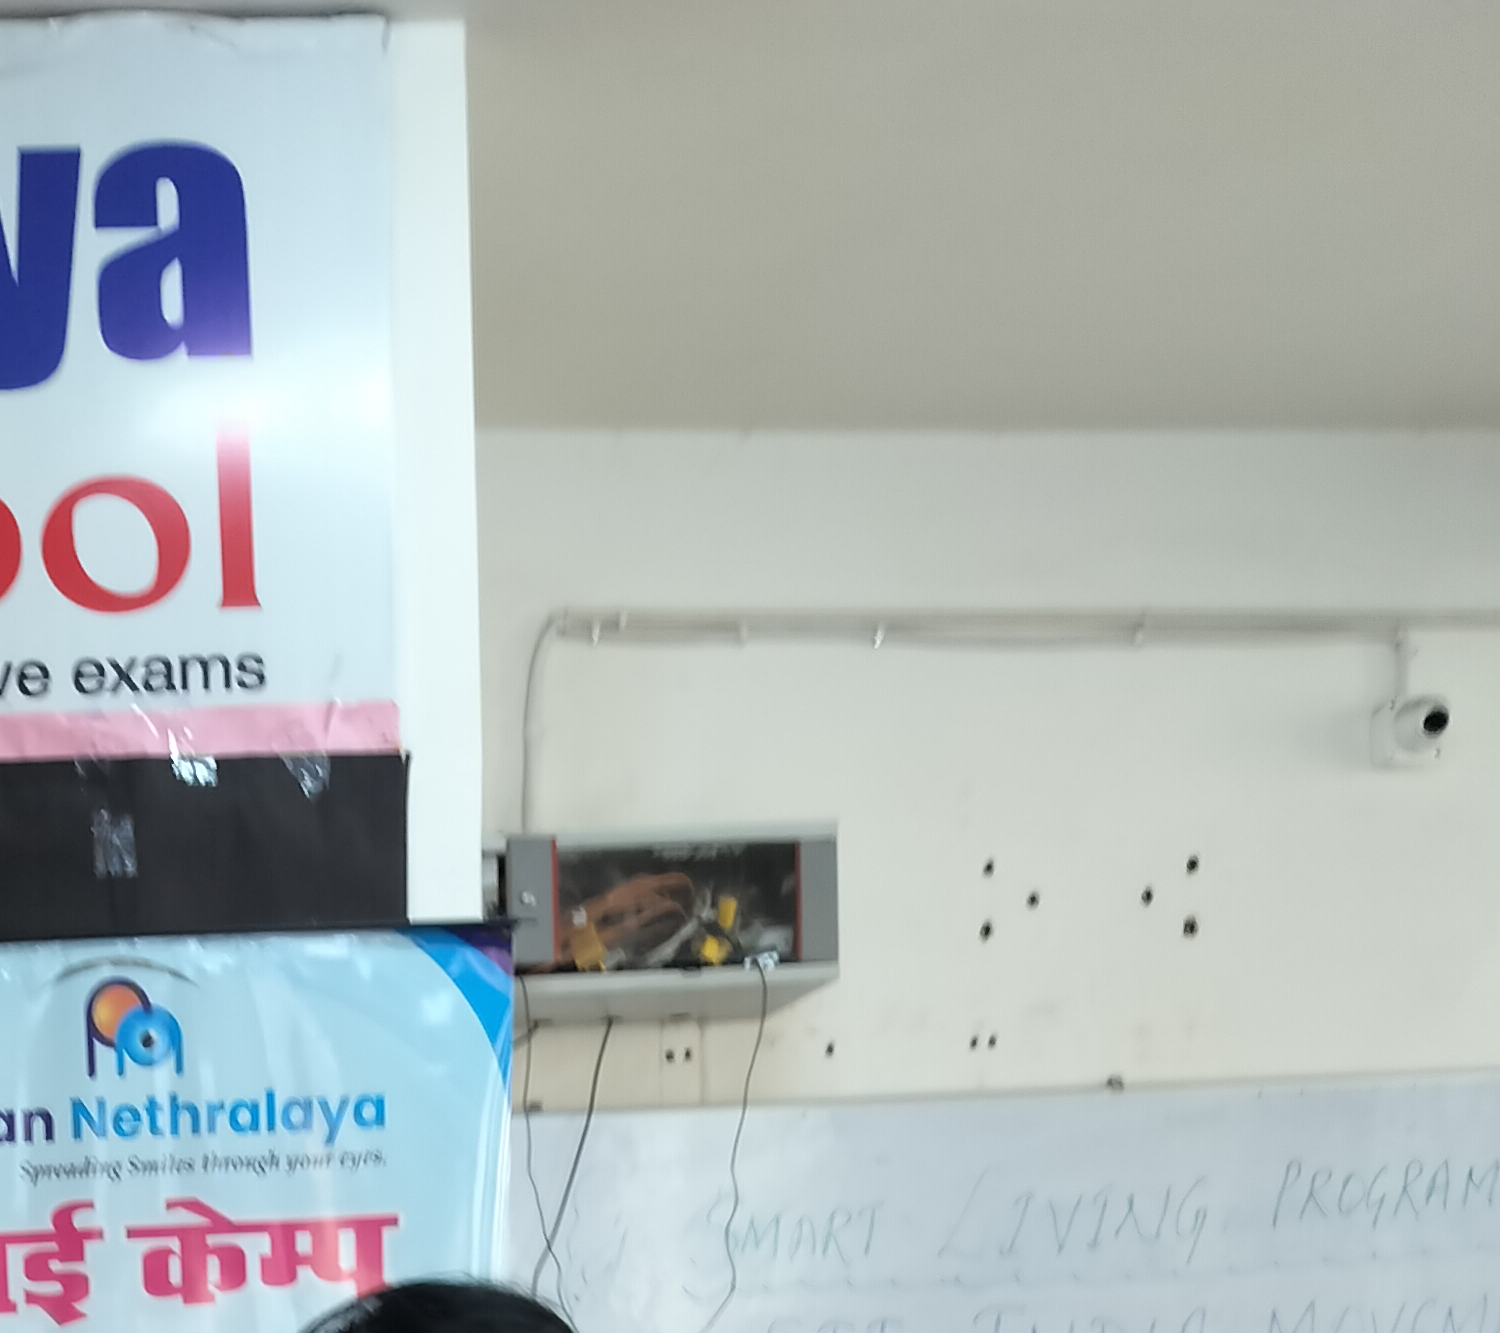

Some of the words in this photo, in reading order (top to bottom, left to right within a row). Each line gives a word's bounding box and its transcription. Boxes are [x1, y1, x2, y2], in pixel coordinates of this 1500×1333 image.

[71, 651, 268, 698] exams
[70, 1088, 387, 1148] Nethralaya
[19, 1154, 122, 1188] Spreading
[127, 1153, 196, 1178] Smiles
[200, 1149, 281, 1178] through
[285, 1150, 333, 1175] your
[690, 1187, 884, 1266] SMART
[937, 1163, 1209, 1266] LIVING
[126, 1195, 400, 1308] केम्प
